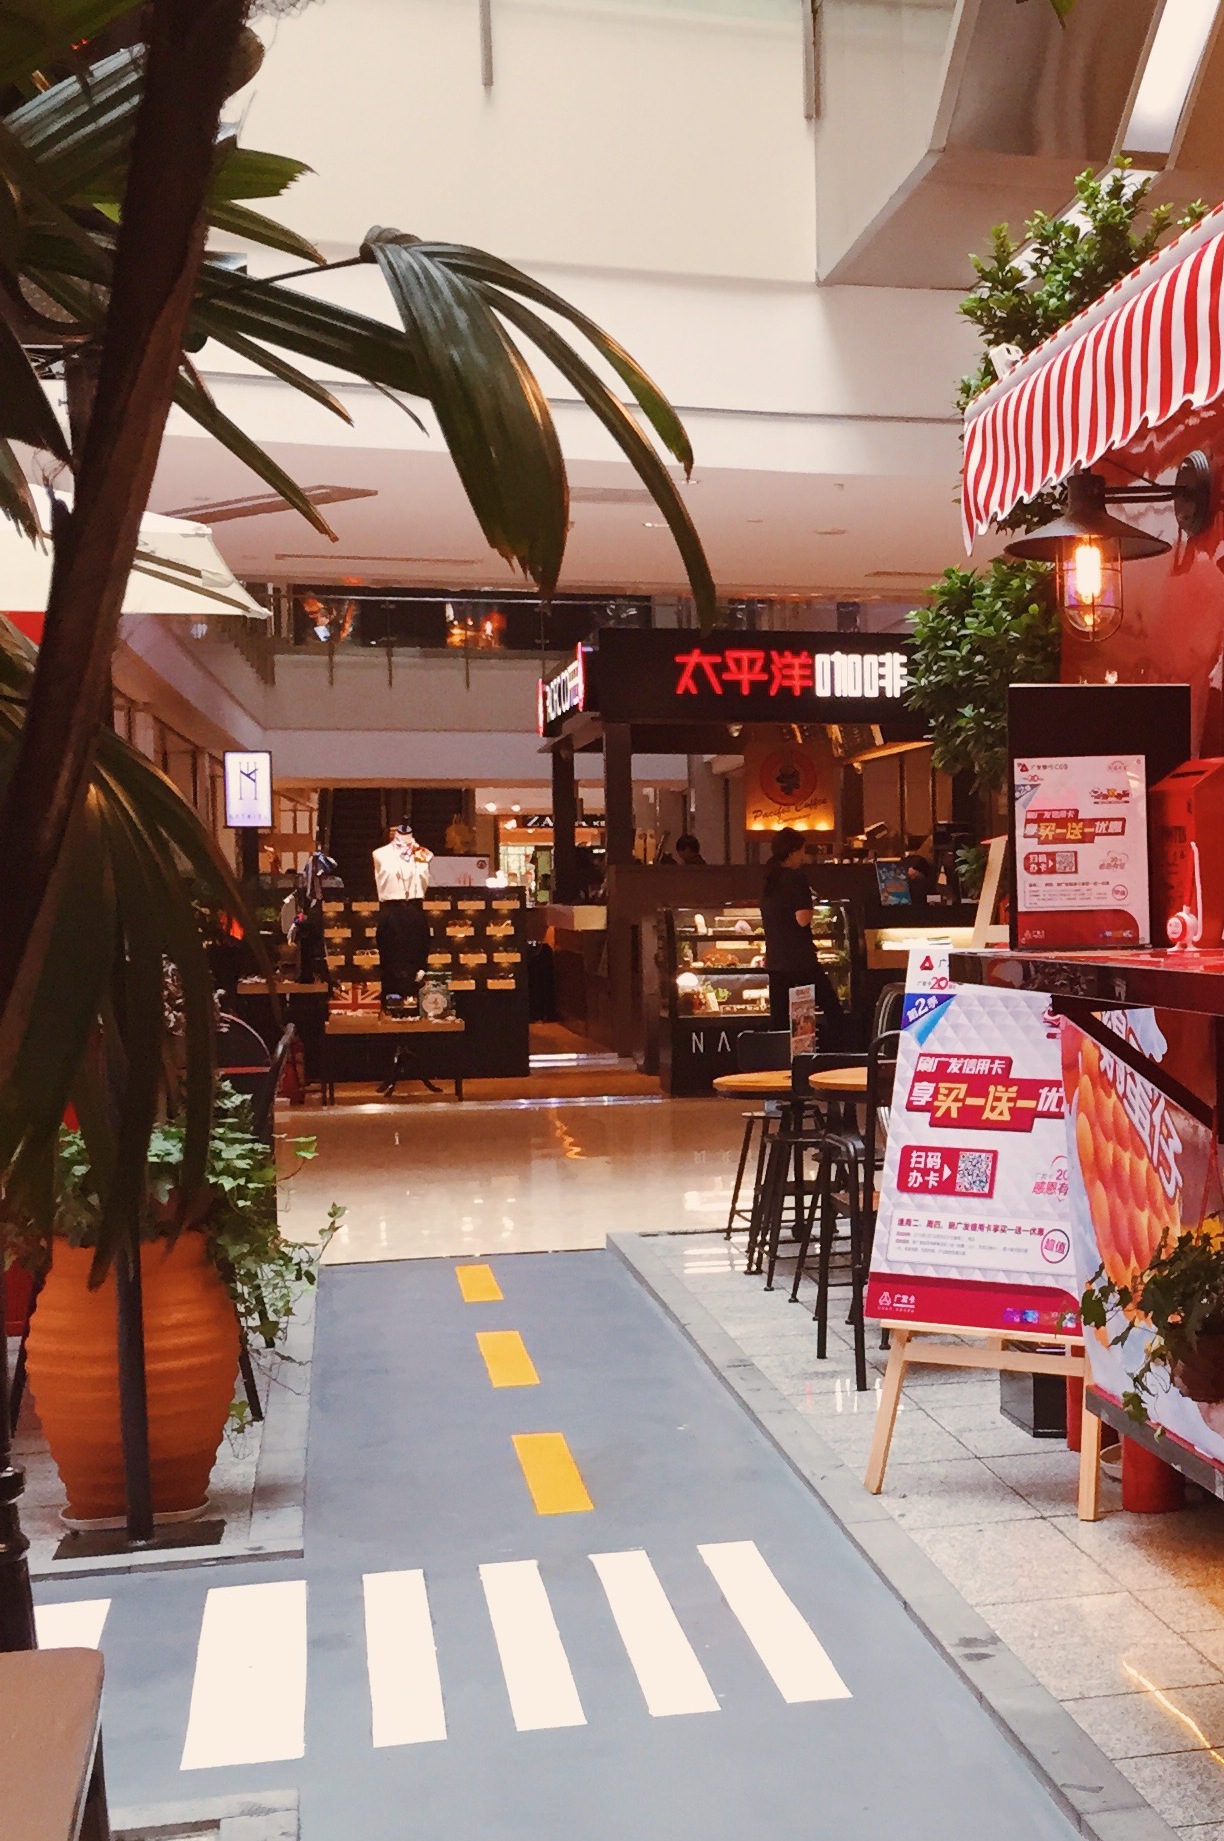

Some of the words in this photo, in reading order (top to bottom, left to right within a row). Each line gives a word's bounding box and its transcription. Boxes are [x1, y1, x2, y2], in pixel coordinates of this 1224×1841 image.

[675, 649, 907, 698] 太平洋咖啡
[527, 815, 589, 827] ZAA
[916, 1056, 1006, 1076] 刷广发信用卡
[909, 1081, 1065, 1121] 享买一送一优
[909, 1150, 942, 1170] 扫码
[907, 1171, 940, 1190] 办卡
